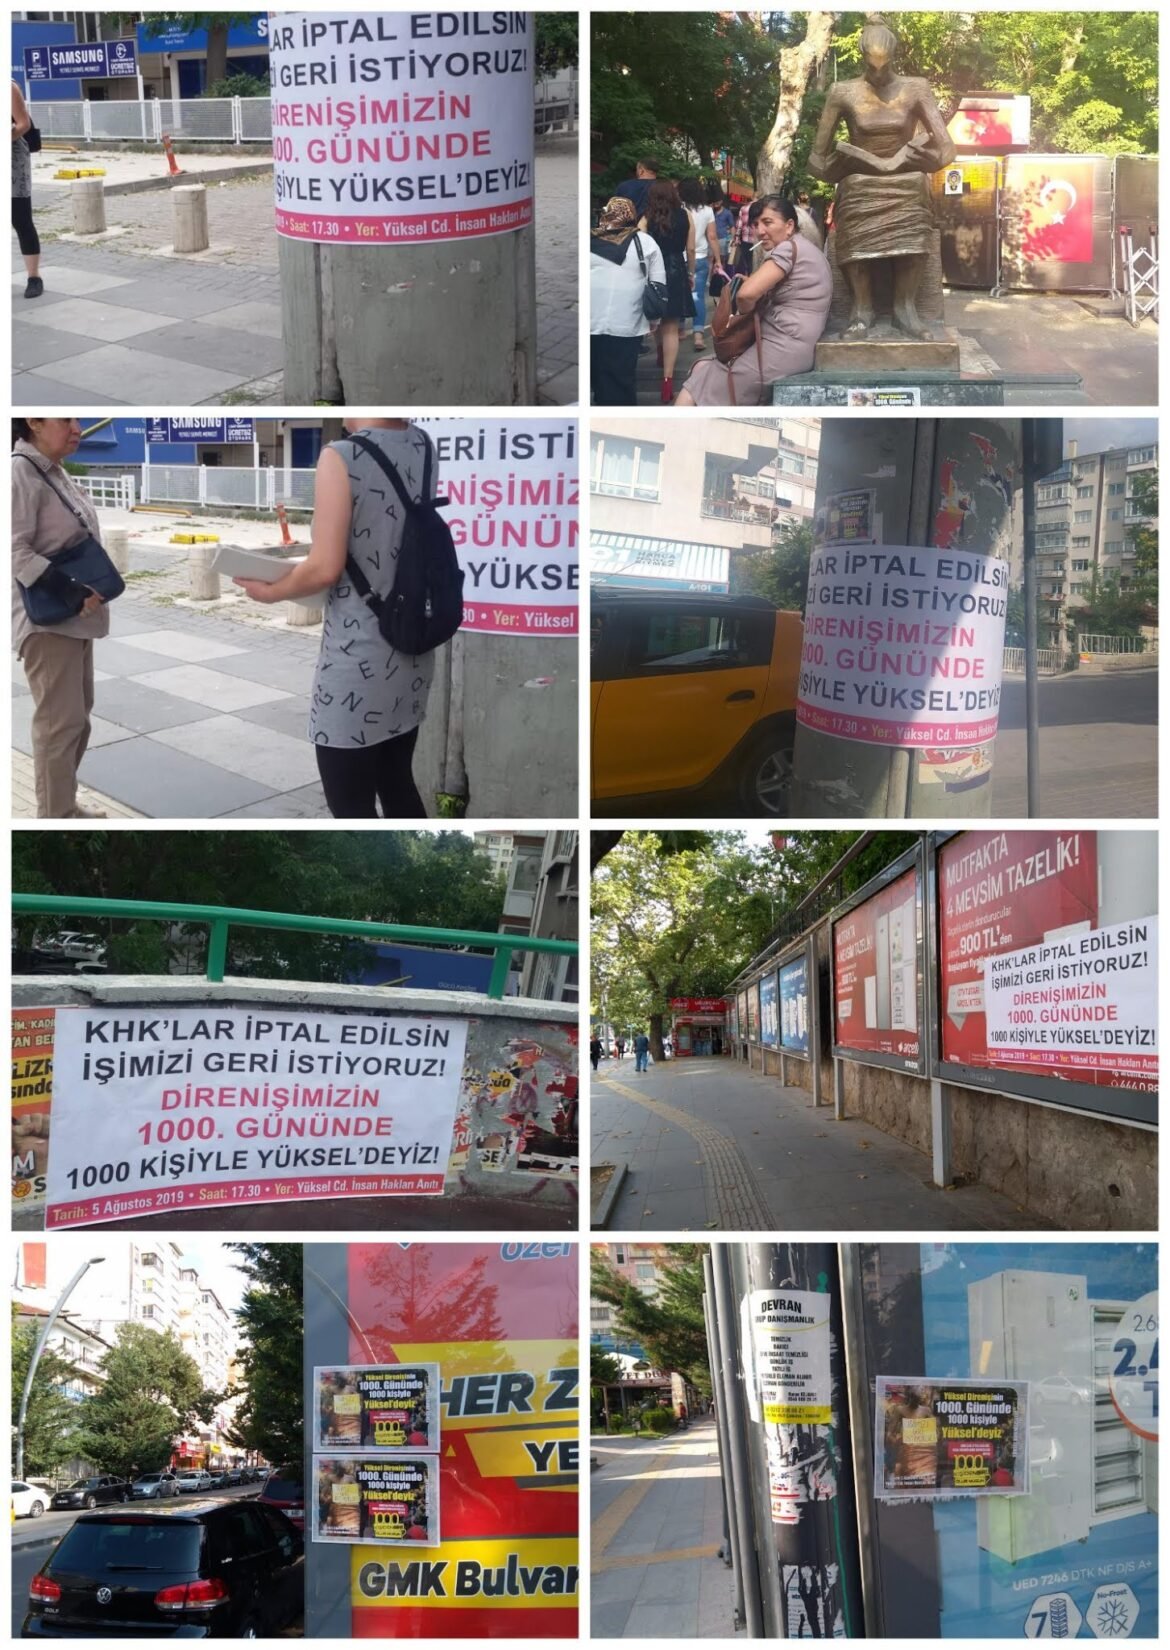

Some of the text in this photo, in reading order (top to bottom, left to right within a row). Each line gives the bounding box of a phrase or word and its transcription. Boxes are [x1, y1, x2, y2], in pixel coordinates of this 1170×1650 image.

[302, 17, 397, 48] İPTAL
[52, 49, 104, 65] SAMSUNG
[280, 49, 527, 88] GERİ İSTİYORUZ!
[307, 130, 491, 164] GÜNÜNDE
[329, 159, 530, 202] YÜKSEL'DEYİZ!
[312, 220, 339, 236] 17.30
[355, 222, 380, 237] Yer:
[383, 220, 427, 237] Yüksel
[431, 219, 452, 234] Cd.
[455, 214, 486, 232] İnsan
[172, 417, 221, 429] SAMSUNG
[499, 426, 575, 460] İSTİ
[844, 550, 926, 577] İPTAL
[819, 581, 872, 606] GERİ
[493, 609, 520, 626] Yer:
[524, 612, 574, 628] Yüksel
[836, 646, 985, 679] GÜNÜNDE
[832, 718, 857, 734] 17.30
[896, 726, 933, 741] Yüksel
[936, 728, 952, 741] Cd.
[955, 724, 977, 740] İnsan
[946, 833, 1009, 889] MUTFAKTA
[946, 834, 1080, 919] 4 MEVSİM TAZELİK!
[960, 931, 981, 955] 900
[991, 952, 1037, 973] KHK'LAR
[1039, 943, 1076, 963] İPTAL
[1080, 925, 1148, 954] EDİLSİN
[991, 951, 1148, 992] İŞİMİZİ GERİ İSTİYORUZ!
[1013, 981, 1107, 1006] DİRENİŞİMİZİN
[1008, 1004, 1118, 1024] 1000. GÜNÜNDE
[85, 1015, 450, 1048] KHK'LAR İPTAL EDİLSİN
[991, 1025, 1156, 1046] 1000 KİŞİYLE YÜKSEL'DEYİZ!
[83, 1048, 446, 1085] İŞİMİZİ GERİ İSTİYORUZ!
[161, 1083, 380, 1112] DİRENİŞİMİZİN
[138, 1112, 394, 1146] 1000. GÜNÜNDE
[66, 1142, 440, 1190] 1000 KİŞİYLE YÜKSEL'DEYİZ!
[53, 1205, 87, 1221] Tarih:
[92, 1202, 100, 1215] 5
[103, 1196, 153, 1215] Ağustos
[156, 1191, 184, 1206] 2019
[199, 1187, 228, 1201] Saat:
[231, 1184, 261, 1199] 17.30
[274, 1183, 294, 1195] Yer:
[297, 1181, 331, 1193] Yüksel
[333, 1179, 349, 1191] Cd.
[352, 1177, 378, 1190] İnsan
[380, 1178, 415, 1190] Hakları
[761, 1298, 802, 1314] DEVRAN
[1133, 1314, 1159, 1332] 2.6
[359, 1380, 423, 1390] 1000. Gününde
[369, 1389, 411, 1399] 1000 kişiyle
[439, 1370, 535, 1417] HER
[944, 1392, 967, 1401] Yüksel
[364, 1399, 416, 1410] Yüksel'deyiz
[936, 1401, 1012, 1414] 1000. Gününde
[947, 1413, 998, 1426] 1000 kişiyle
[942, 1427, 1002, 1440] Yüksel'deyiz
[358, 1471, 423, 1482] 1000. Gününde
[368, 1480, 411, 1491] 1000 kişiyle
[363, 1490, 415, 1501] Yüksel'deyiz
[358, 1559, 449, 1598] GMK
[1012, 1560, 1153, 1591] UED 7246 DTK NF D/S A+
[1096, 1588, 1128, 1600] No-Frost
[1031, 1612, 1049, 1638] 7
